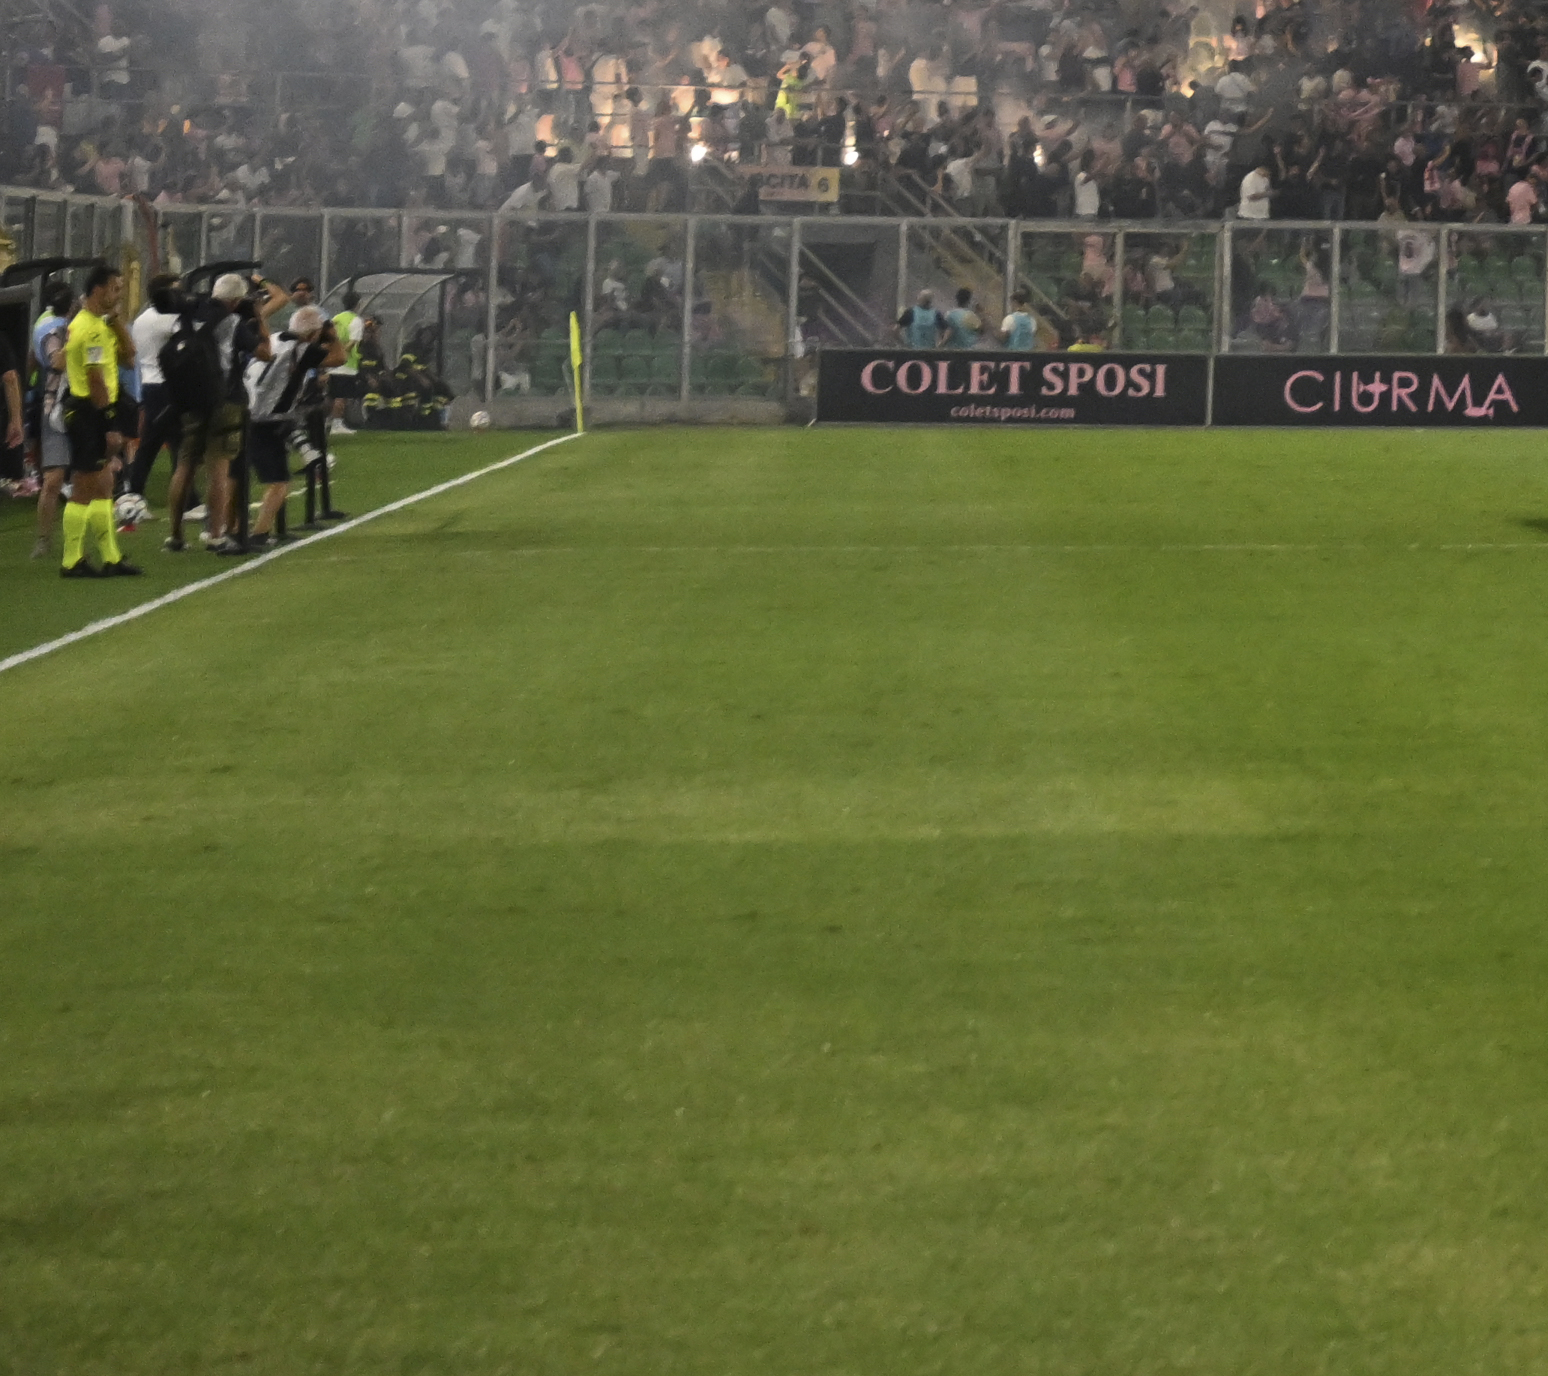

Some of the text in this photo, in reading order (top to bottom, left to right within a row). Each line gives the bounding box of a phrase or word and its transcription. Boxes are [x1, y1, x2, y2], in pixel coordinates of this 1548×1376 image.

[817, 177, 830, 193] 6
[860, 359, 1168, 399] COLET SPOSI
[949, 402, 1076, 422] coletsposi.com
